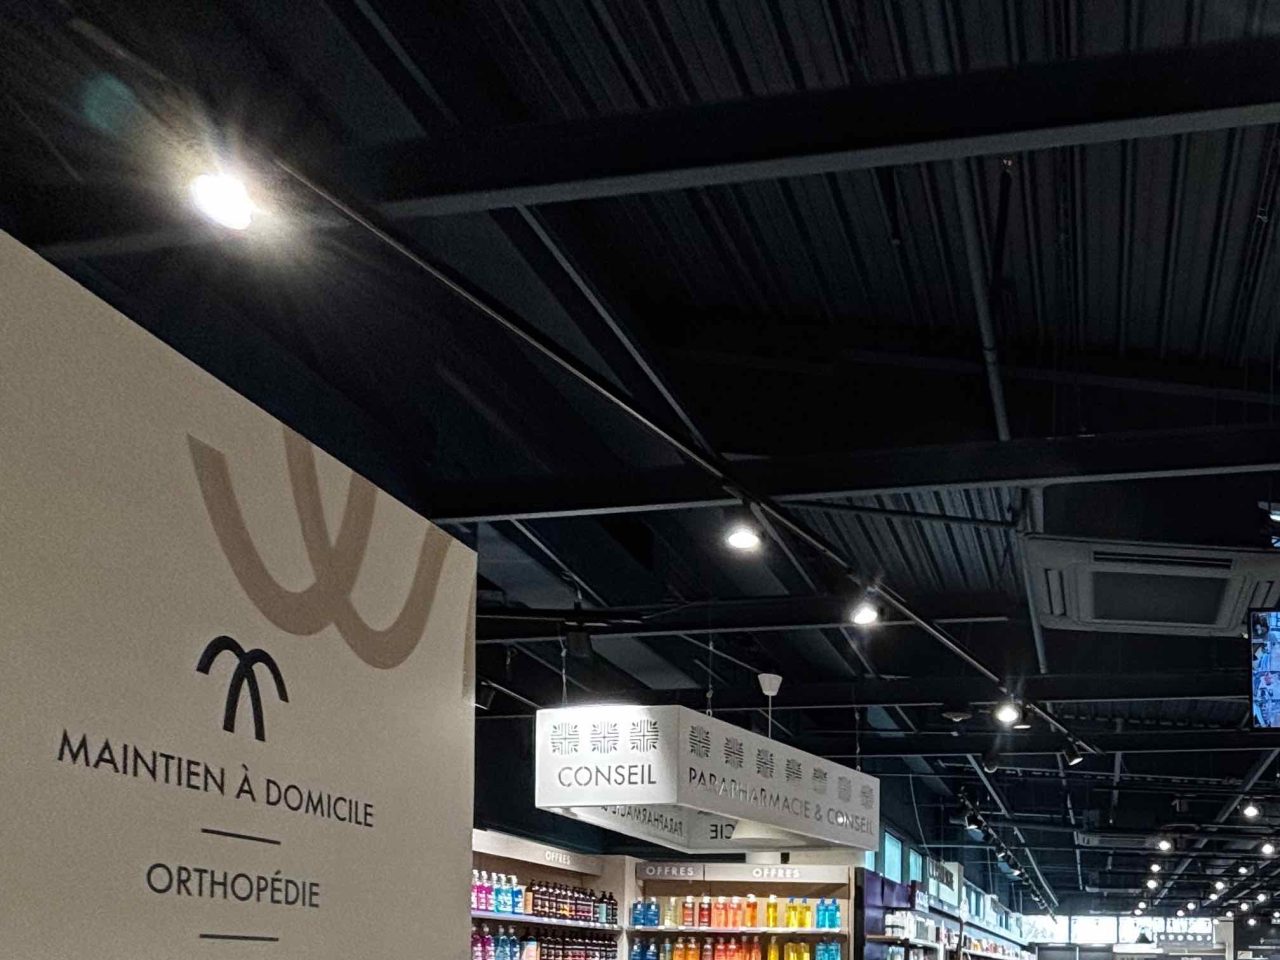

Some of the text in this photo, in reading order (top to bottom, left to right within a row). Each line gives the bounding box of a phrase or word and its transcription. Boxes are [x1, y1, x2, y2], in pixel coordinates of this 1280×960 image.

[57, 729, 374, 828] MAINTIEN À DOMICILE
[558, 764, 657, 788] CONSEIL
[827, 808, 874, 835] CONSEIL
[546, 851, 571, 866] OFFRES
[646, 866, 694, 877] OFFRES
[752, 867, 801, 879] OFFRES
[146, 863, 320, 908] ORTHOPÉDIE
